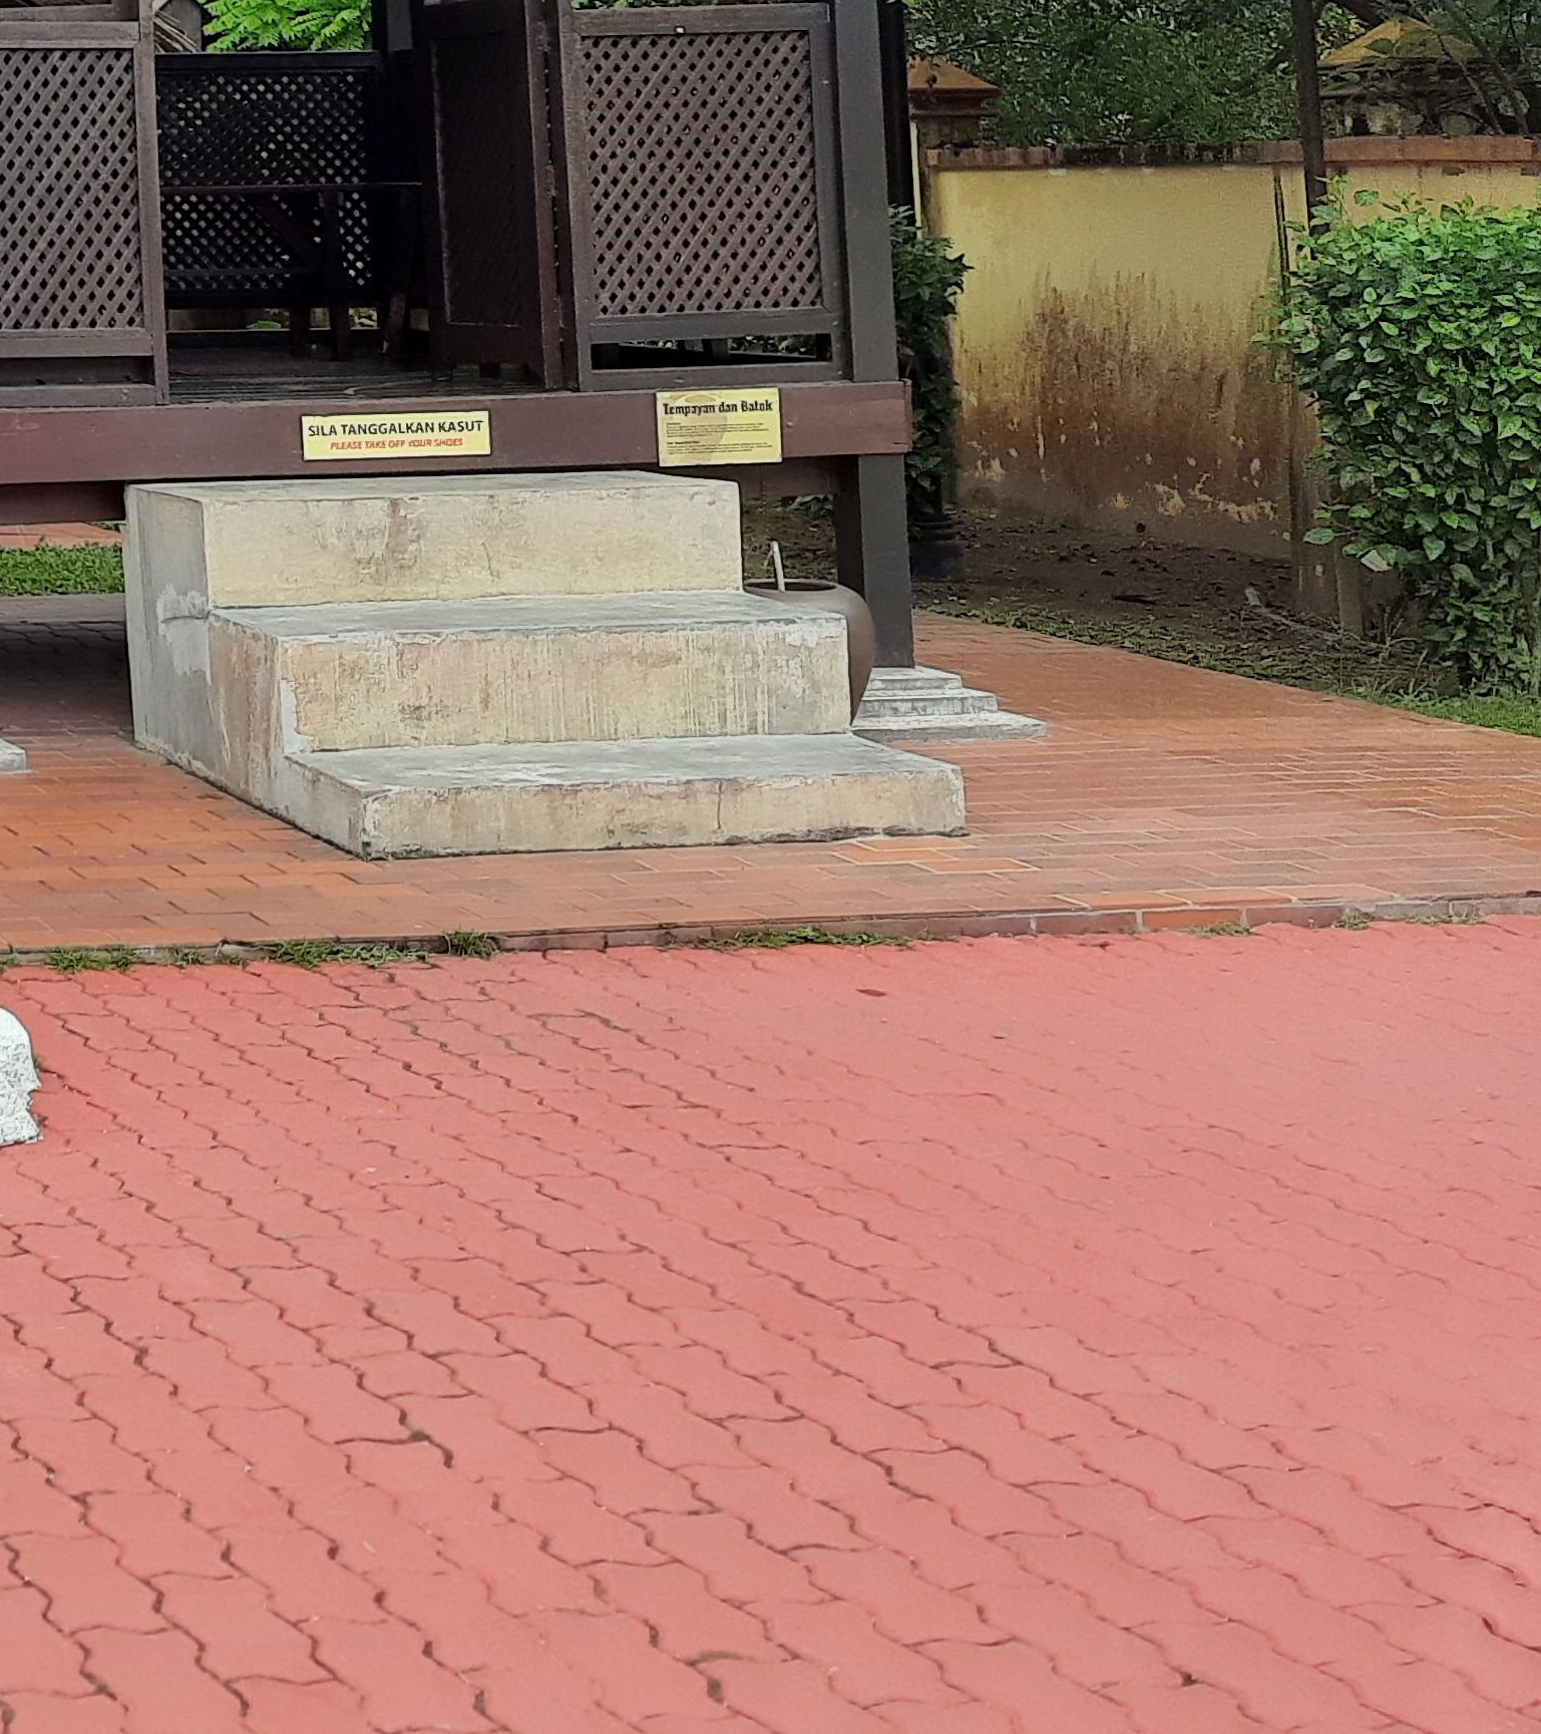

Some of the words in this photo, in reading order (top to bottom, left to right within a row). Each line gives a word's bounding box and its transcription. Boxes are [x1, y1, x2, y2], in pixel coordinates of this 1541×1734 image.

[663, 402, 716, 417] Tempayan
[718, 401, 738, 413] dan
[308, 425, 338, 437] SILA
[341, 422, 435, 436] TANGGALKAN
[438, 420, 484, 433] KASUT
[330, 441, 362, 450] PLEASE
[365, 440, 386, 449] TAKE
[388, 440, 405, 448] OFF
[408, 439, 432, 447] YOUR
[434, 438, 463, 447] SHOES
